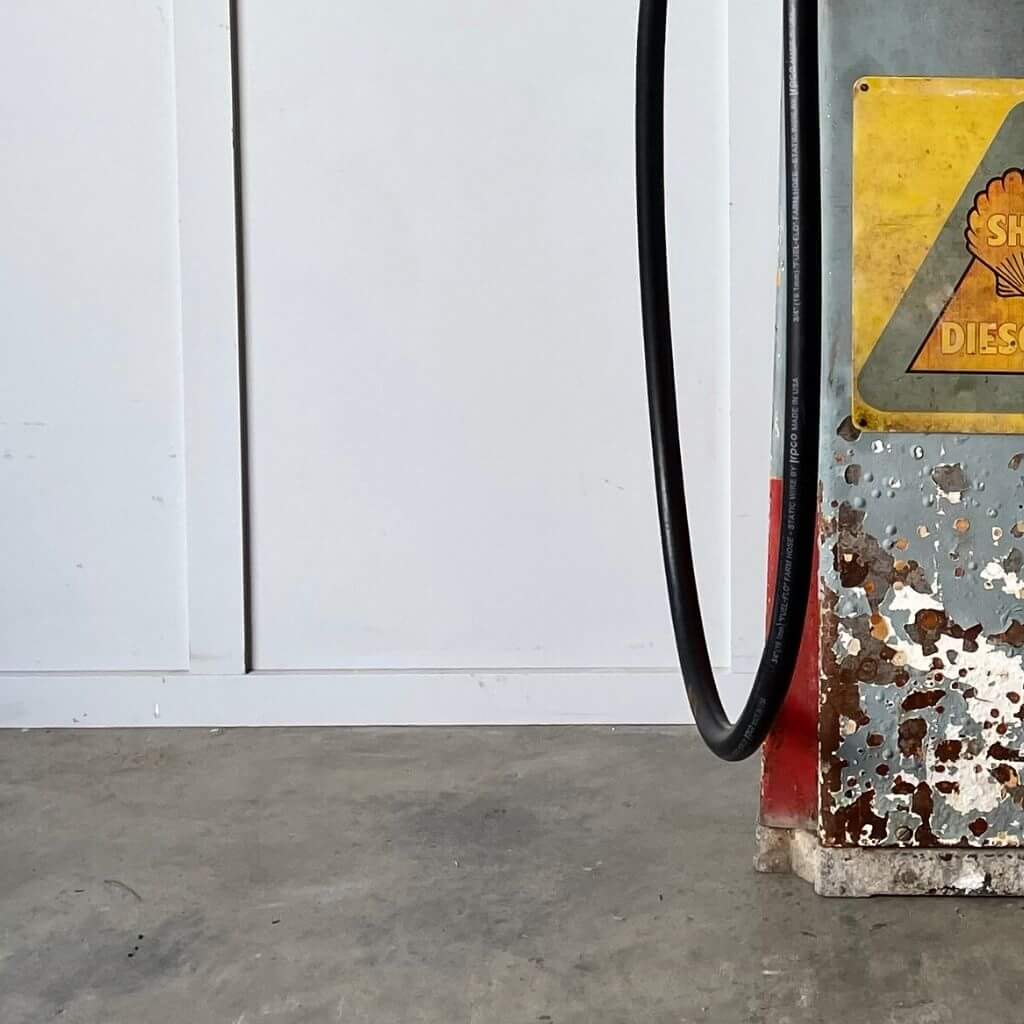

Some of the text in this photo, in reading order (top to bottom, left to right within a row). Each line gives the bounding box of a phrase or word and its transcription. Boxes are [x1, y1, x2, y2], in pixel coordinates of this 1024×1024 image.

[792, 376, 800, 395] USA
[792, 396, 799, 406] IN
[791, 407, 799, 431] MADE
[787, 502, 796, 530] STATIC
[785, 536, 795, 560] HOSE
[783, 561, 793, 582] FARM
